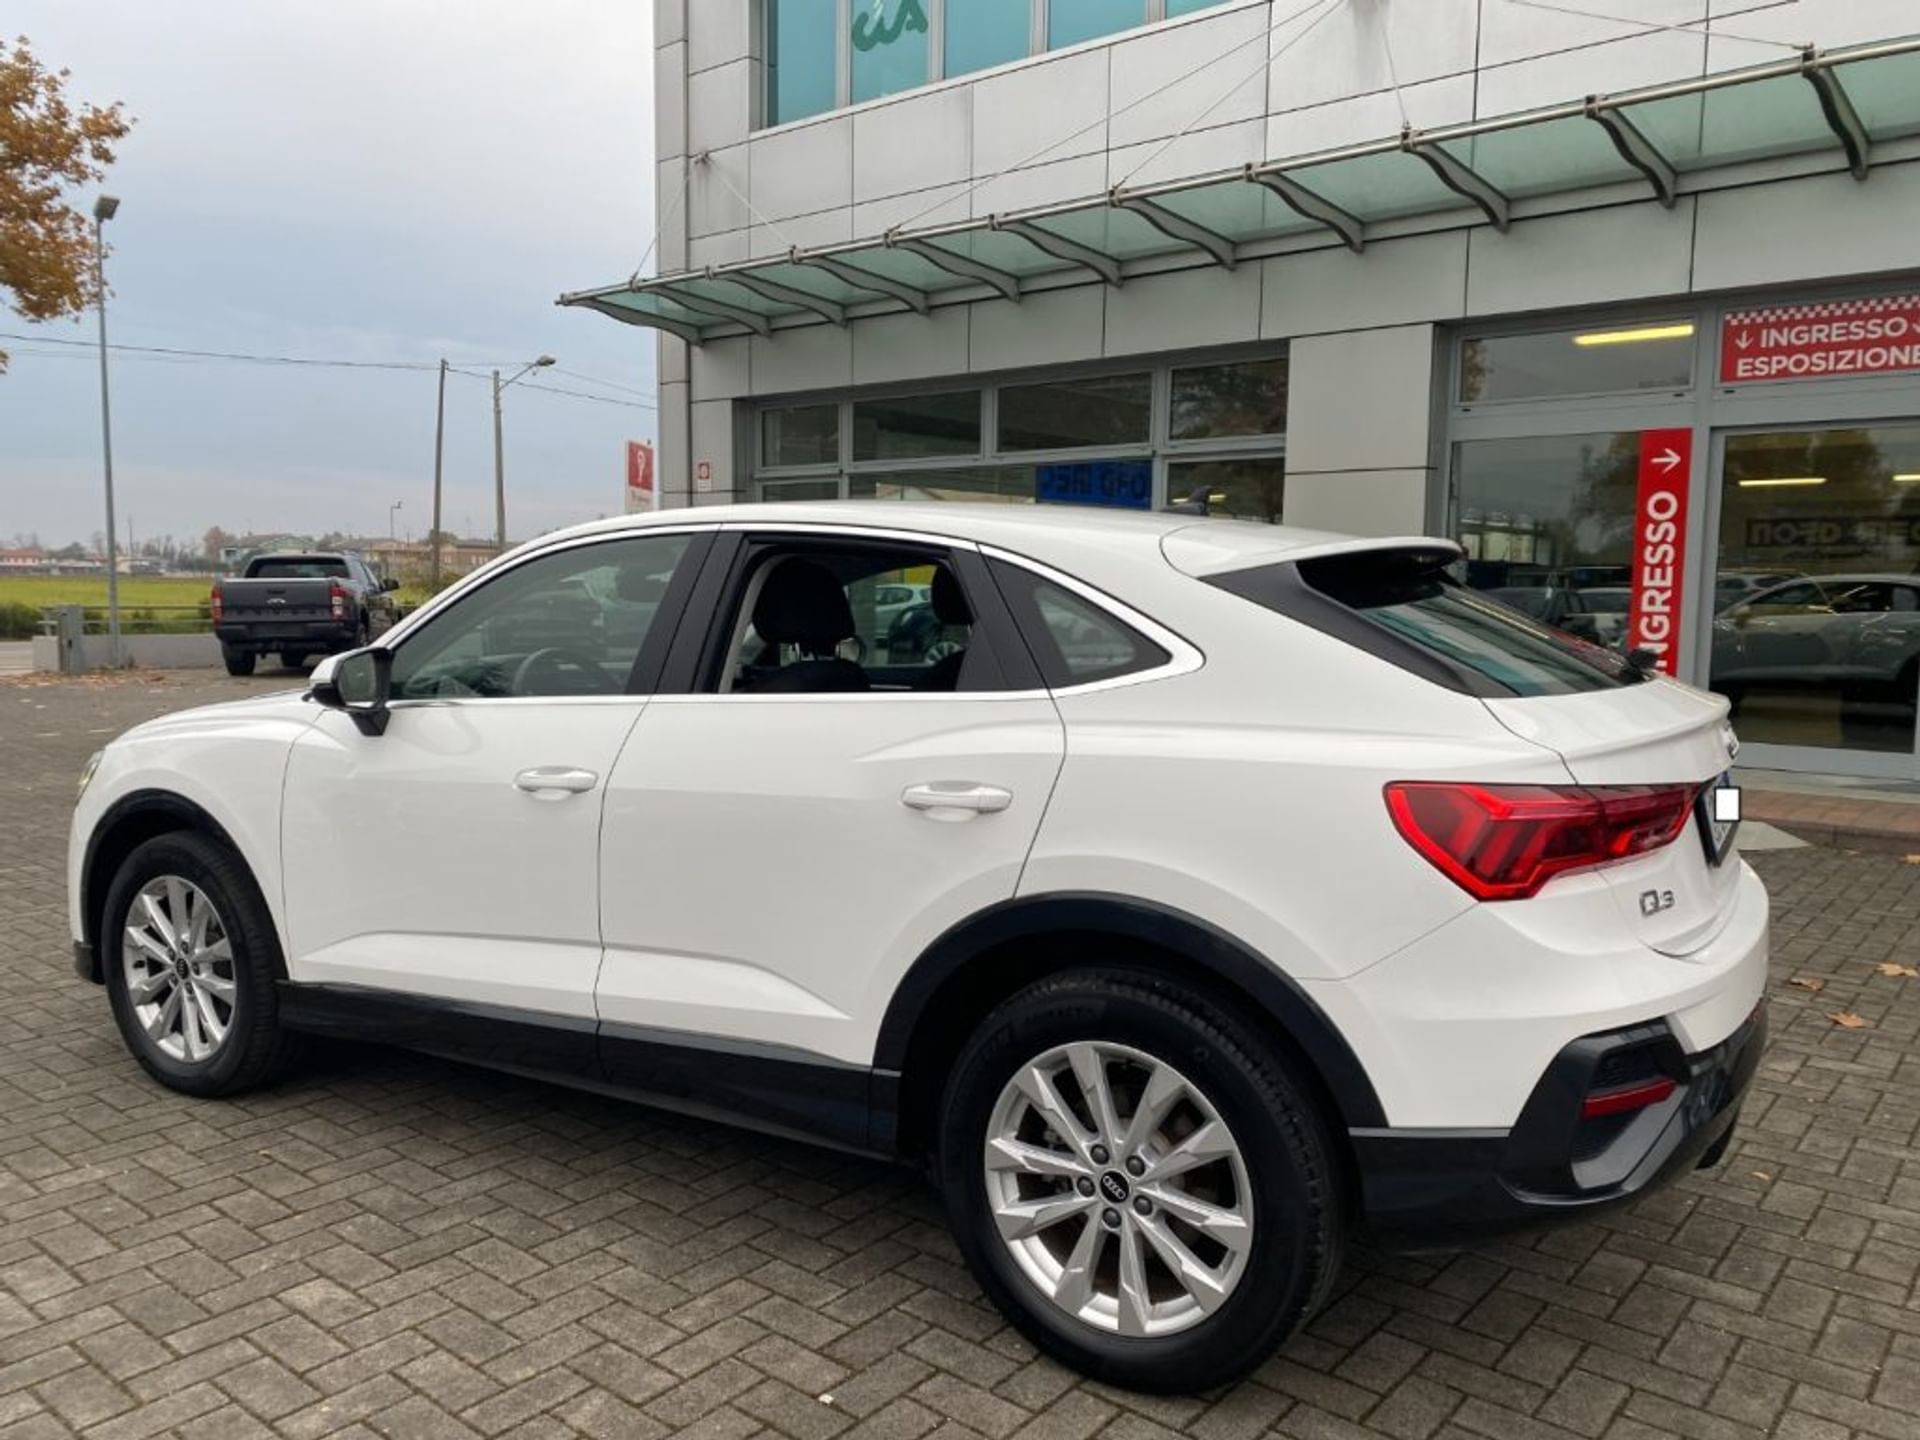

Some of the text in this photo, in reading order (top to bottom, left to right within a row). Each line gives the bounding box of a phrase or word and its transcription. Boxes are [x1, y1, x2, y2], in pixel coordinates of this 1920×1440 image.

[1760, 317, 1908, 349] INGRESSO
[1638, 490, 1679, 677] NGRESSO
[1639, 889, 1676, 917] Q3
